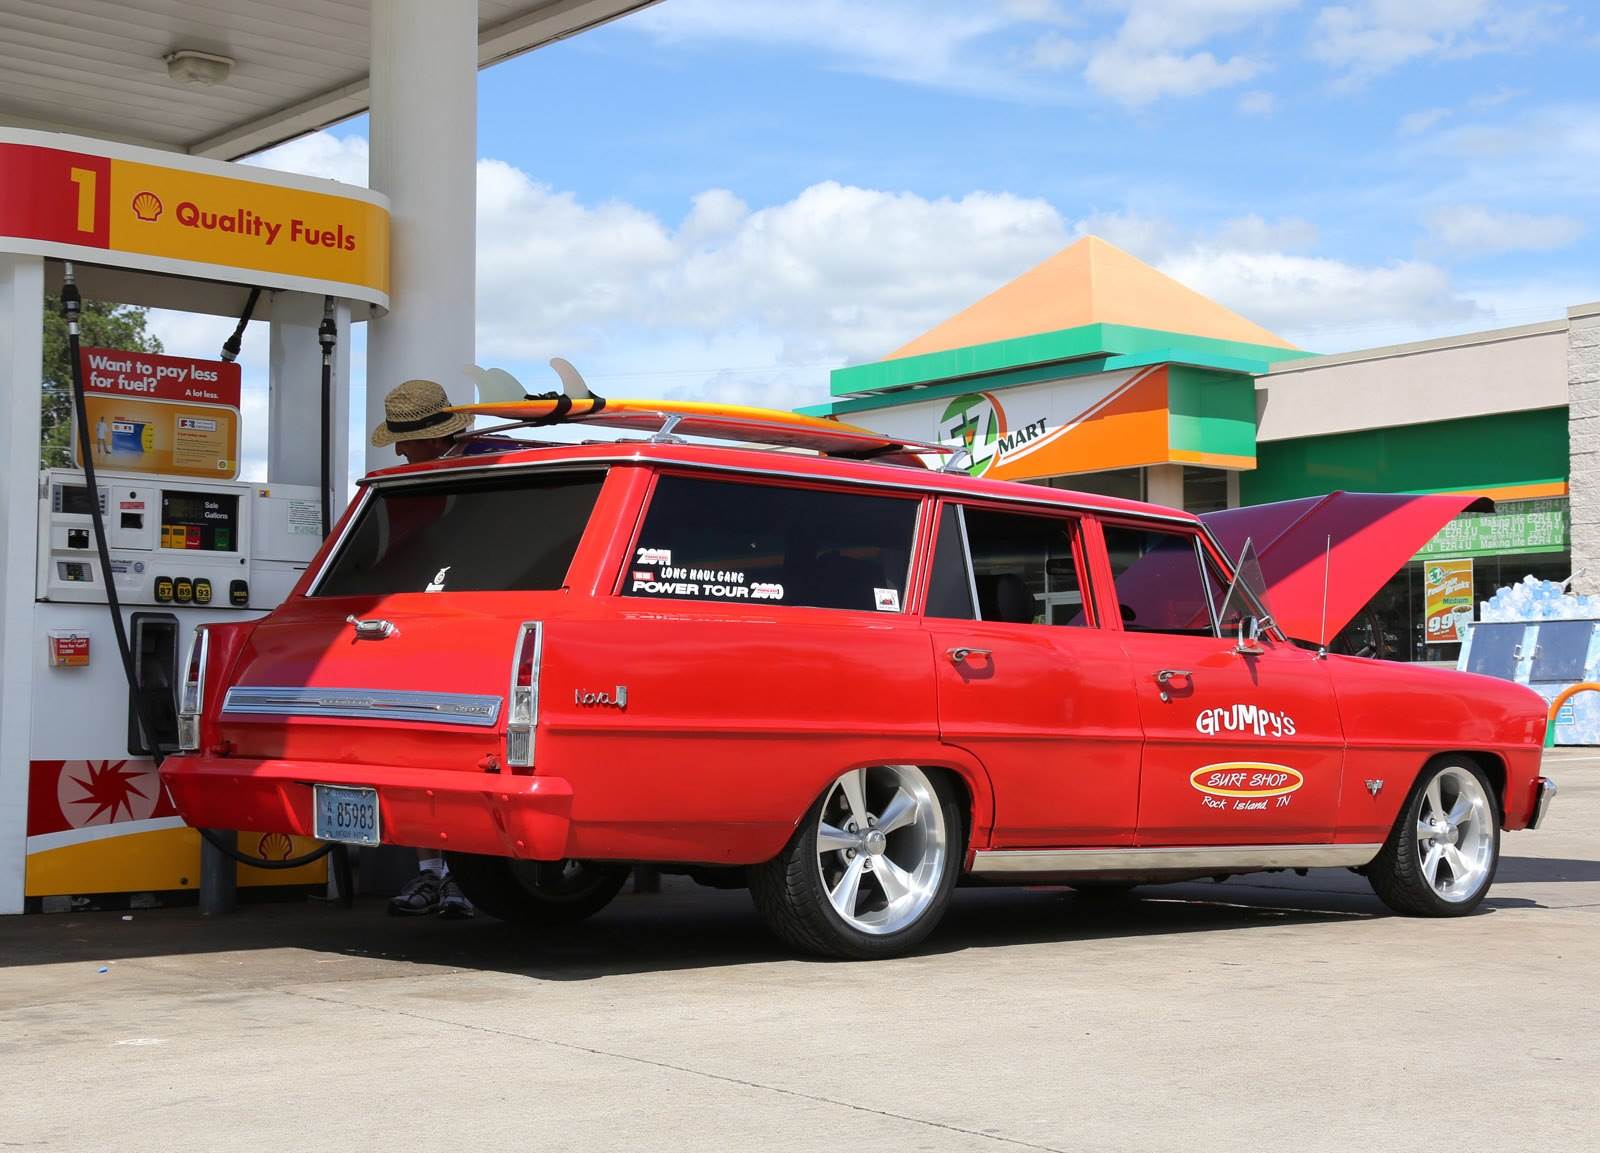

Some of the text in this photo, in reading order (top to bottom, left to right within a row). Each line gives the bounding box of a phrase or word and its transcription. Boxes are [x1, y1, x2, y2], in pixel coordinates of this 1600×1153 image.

[70, 167, 96, 233] 1
[176, 201, 356, 251] Quality Fuels
[88, 354, 218, 382] Want to pay less
[89, 371, 158, 393] for fuel?
[185, 389, 192, 397] A
[192, 389, 203, 397] lot
[997, 417, 1048, 455] MART
[204, 501, 219, 510] Sale
[204, 511, 228, 520] Gallons
[660, 566, 687, 580] LONG
[689, 568, 716, 582] HAUL
[717, 570, 745, 584] GANG
[159, 587, 172, 596] 87
[178, 587, 191, 596] 89
[197, 588, 210, 597] 93
[632, 581, 699, 596] POWER
[702, 584, 749, 598] TOUR
[575, 688, 618, 705] Nova
[1207, 772, 1288, 788] SURF SHOP
[1201, 795, 1228, 810] Rock
[1275, 795, 1291, 808] TN
[337, 802, 374, 830] 85983
